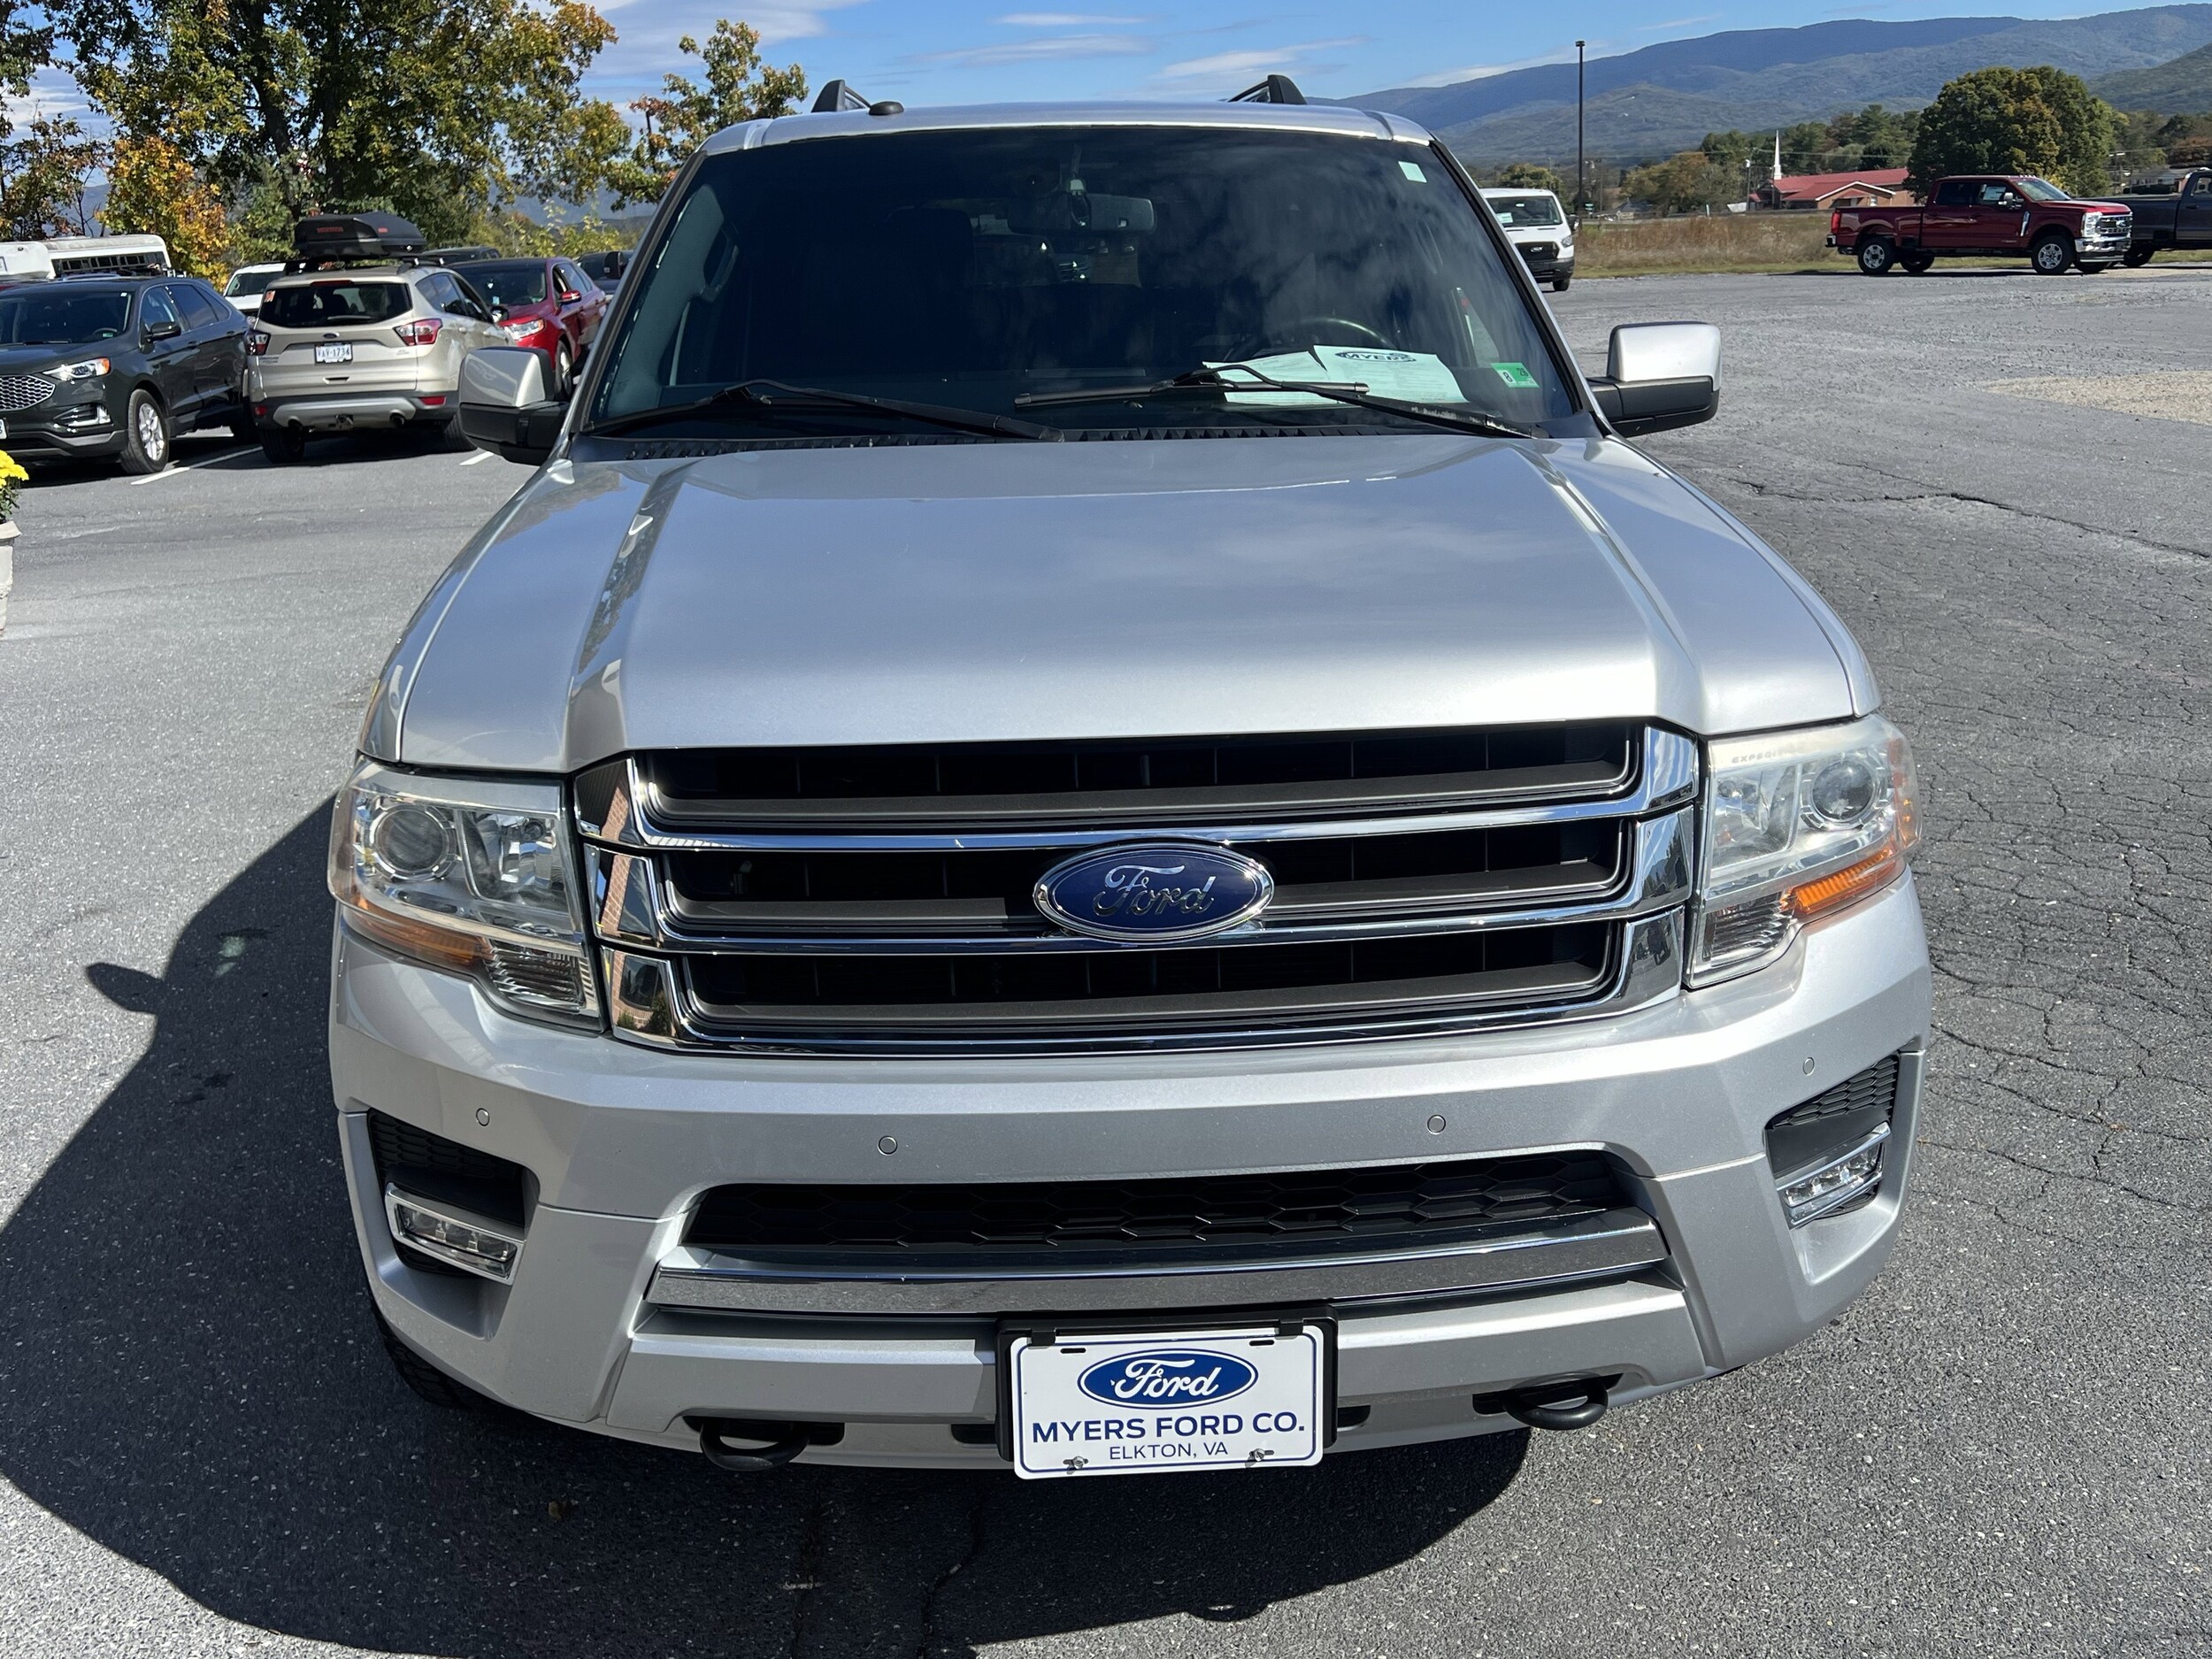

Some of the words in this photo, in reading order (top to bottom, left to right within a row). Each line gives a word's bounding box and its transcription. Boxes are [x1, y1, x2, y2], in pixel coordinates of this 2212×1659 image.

[1093, 864, 1217, 917] Ford
[1110, 1358, 1222, 1399] Ford
[1032, 1417, 1146, 1443] MYERS
[1156, 1414, 1244, 1438] FORD
[1252, 1411, 1305, 1433] CO.
[1109, 1443, 1197, 1460] ELKTON,
[1203, 1441, 1228, 1455] VA
